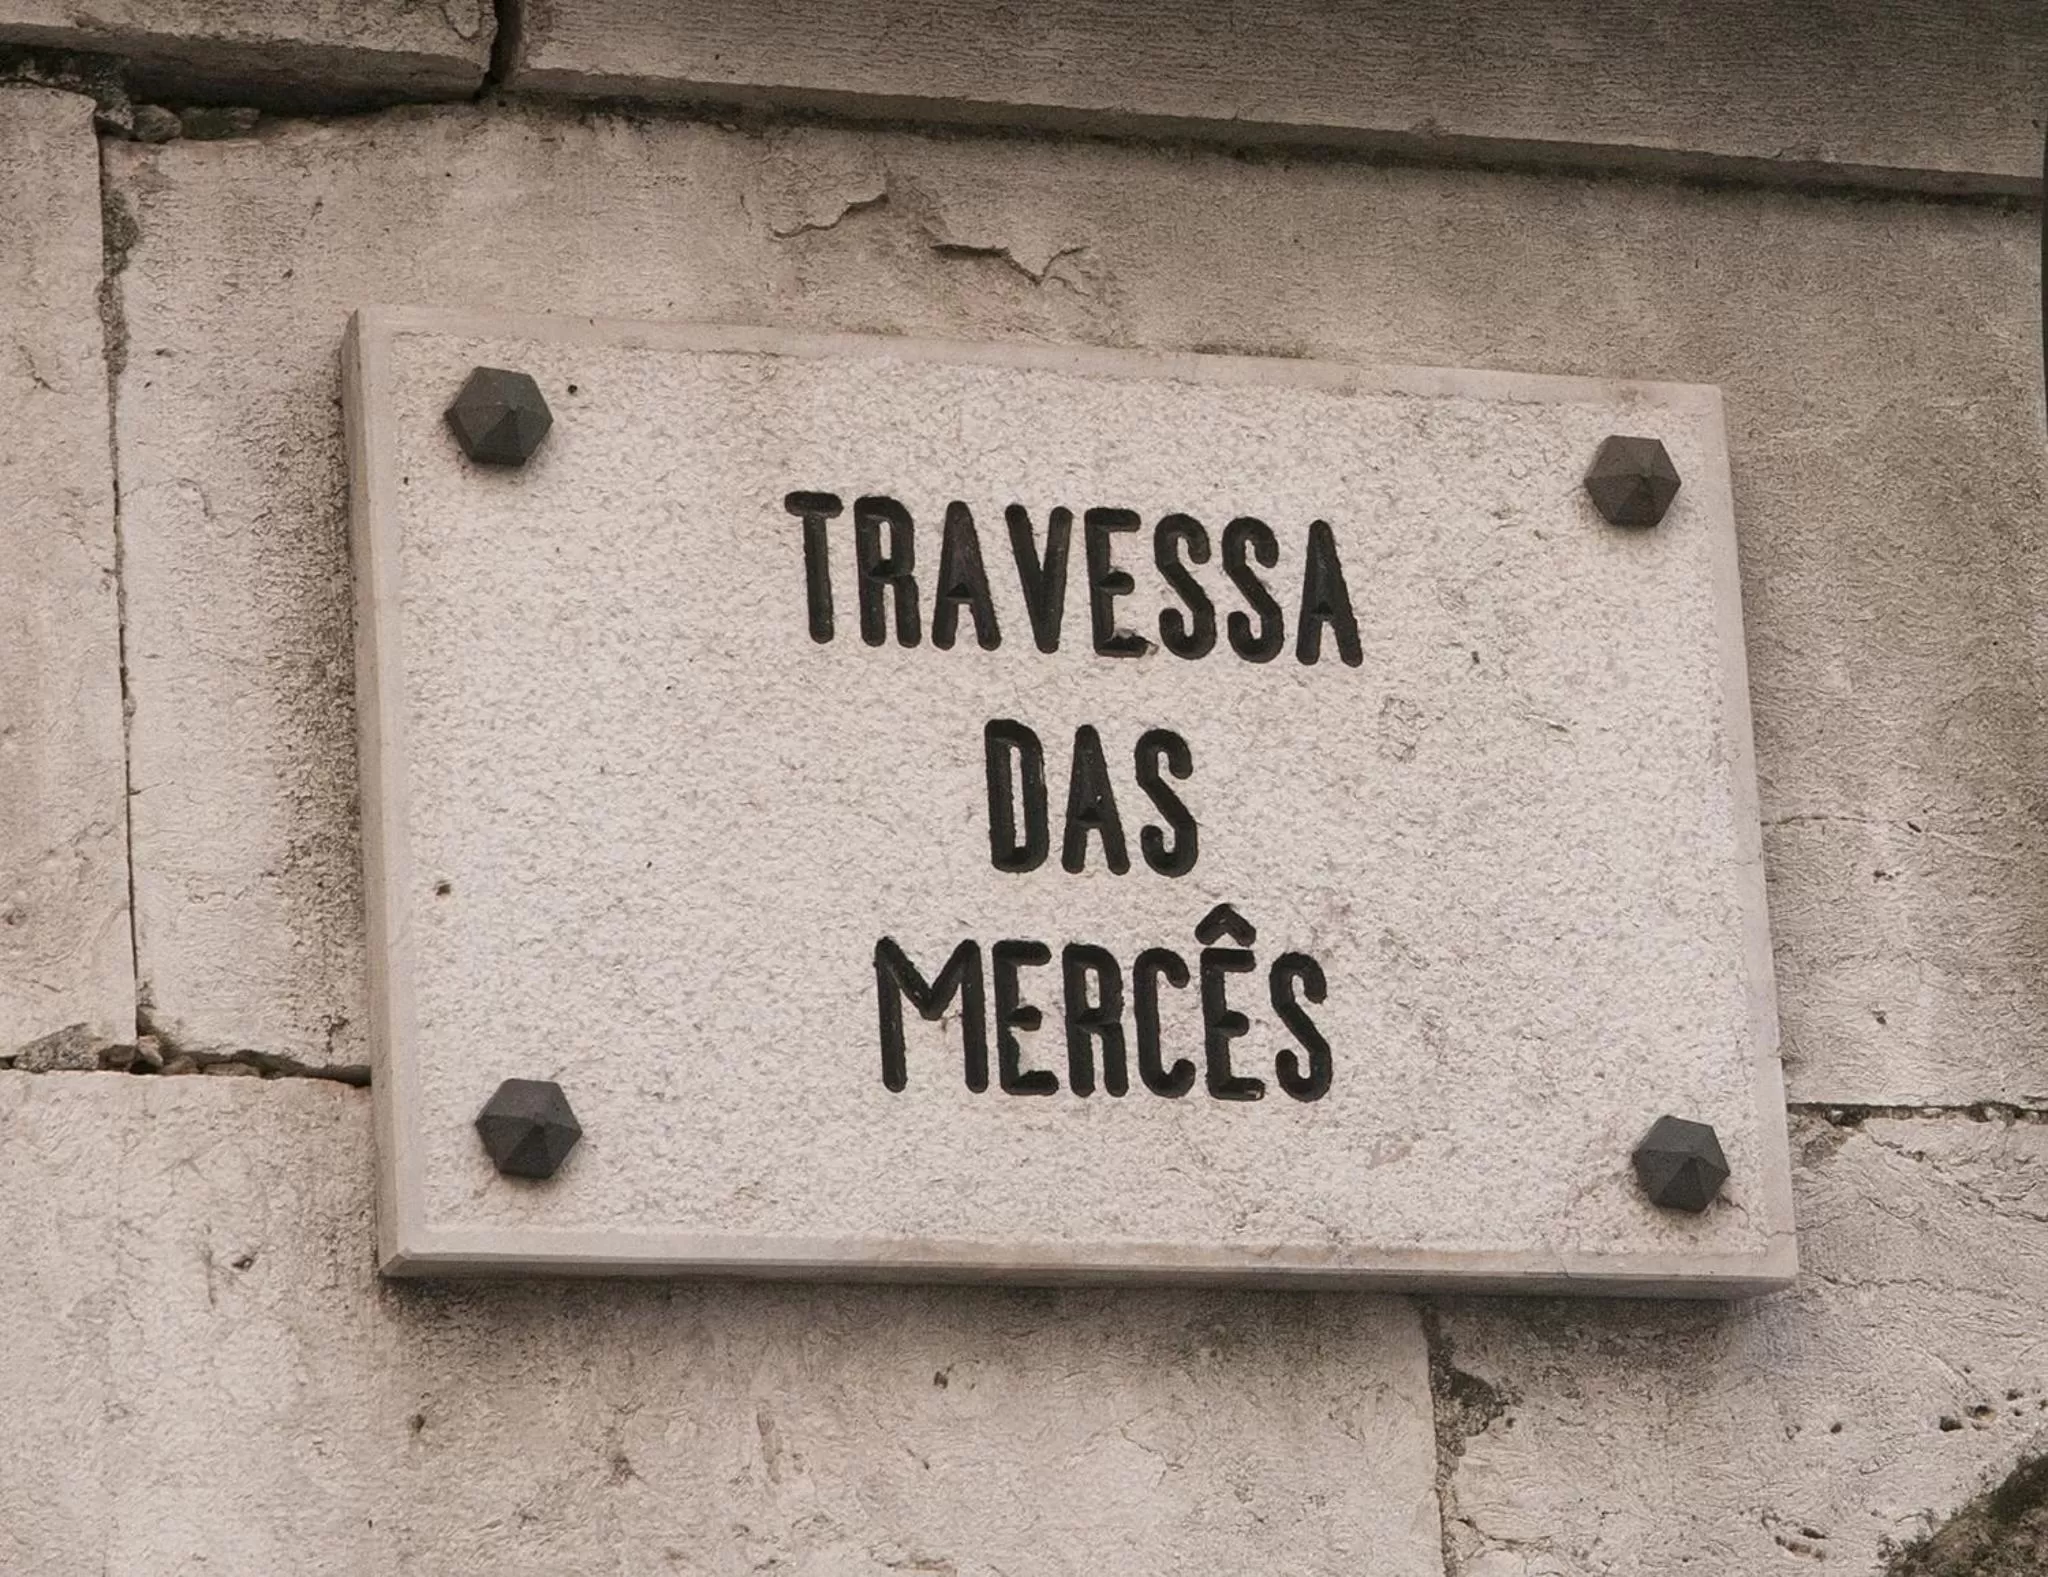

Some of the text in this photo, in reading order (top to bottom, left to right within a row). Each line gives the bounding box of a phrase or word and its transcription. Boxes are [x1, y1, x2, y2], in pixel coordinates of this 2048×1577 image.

[785, 491, 1363, 667] TRAVESSA
[985, 719, 1198, 878] DAS
[873, 903, 1333, 1103] MERCÊS
